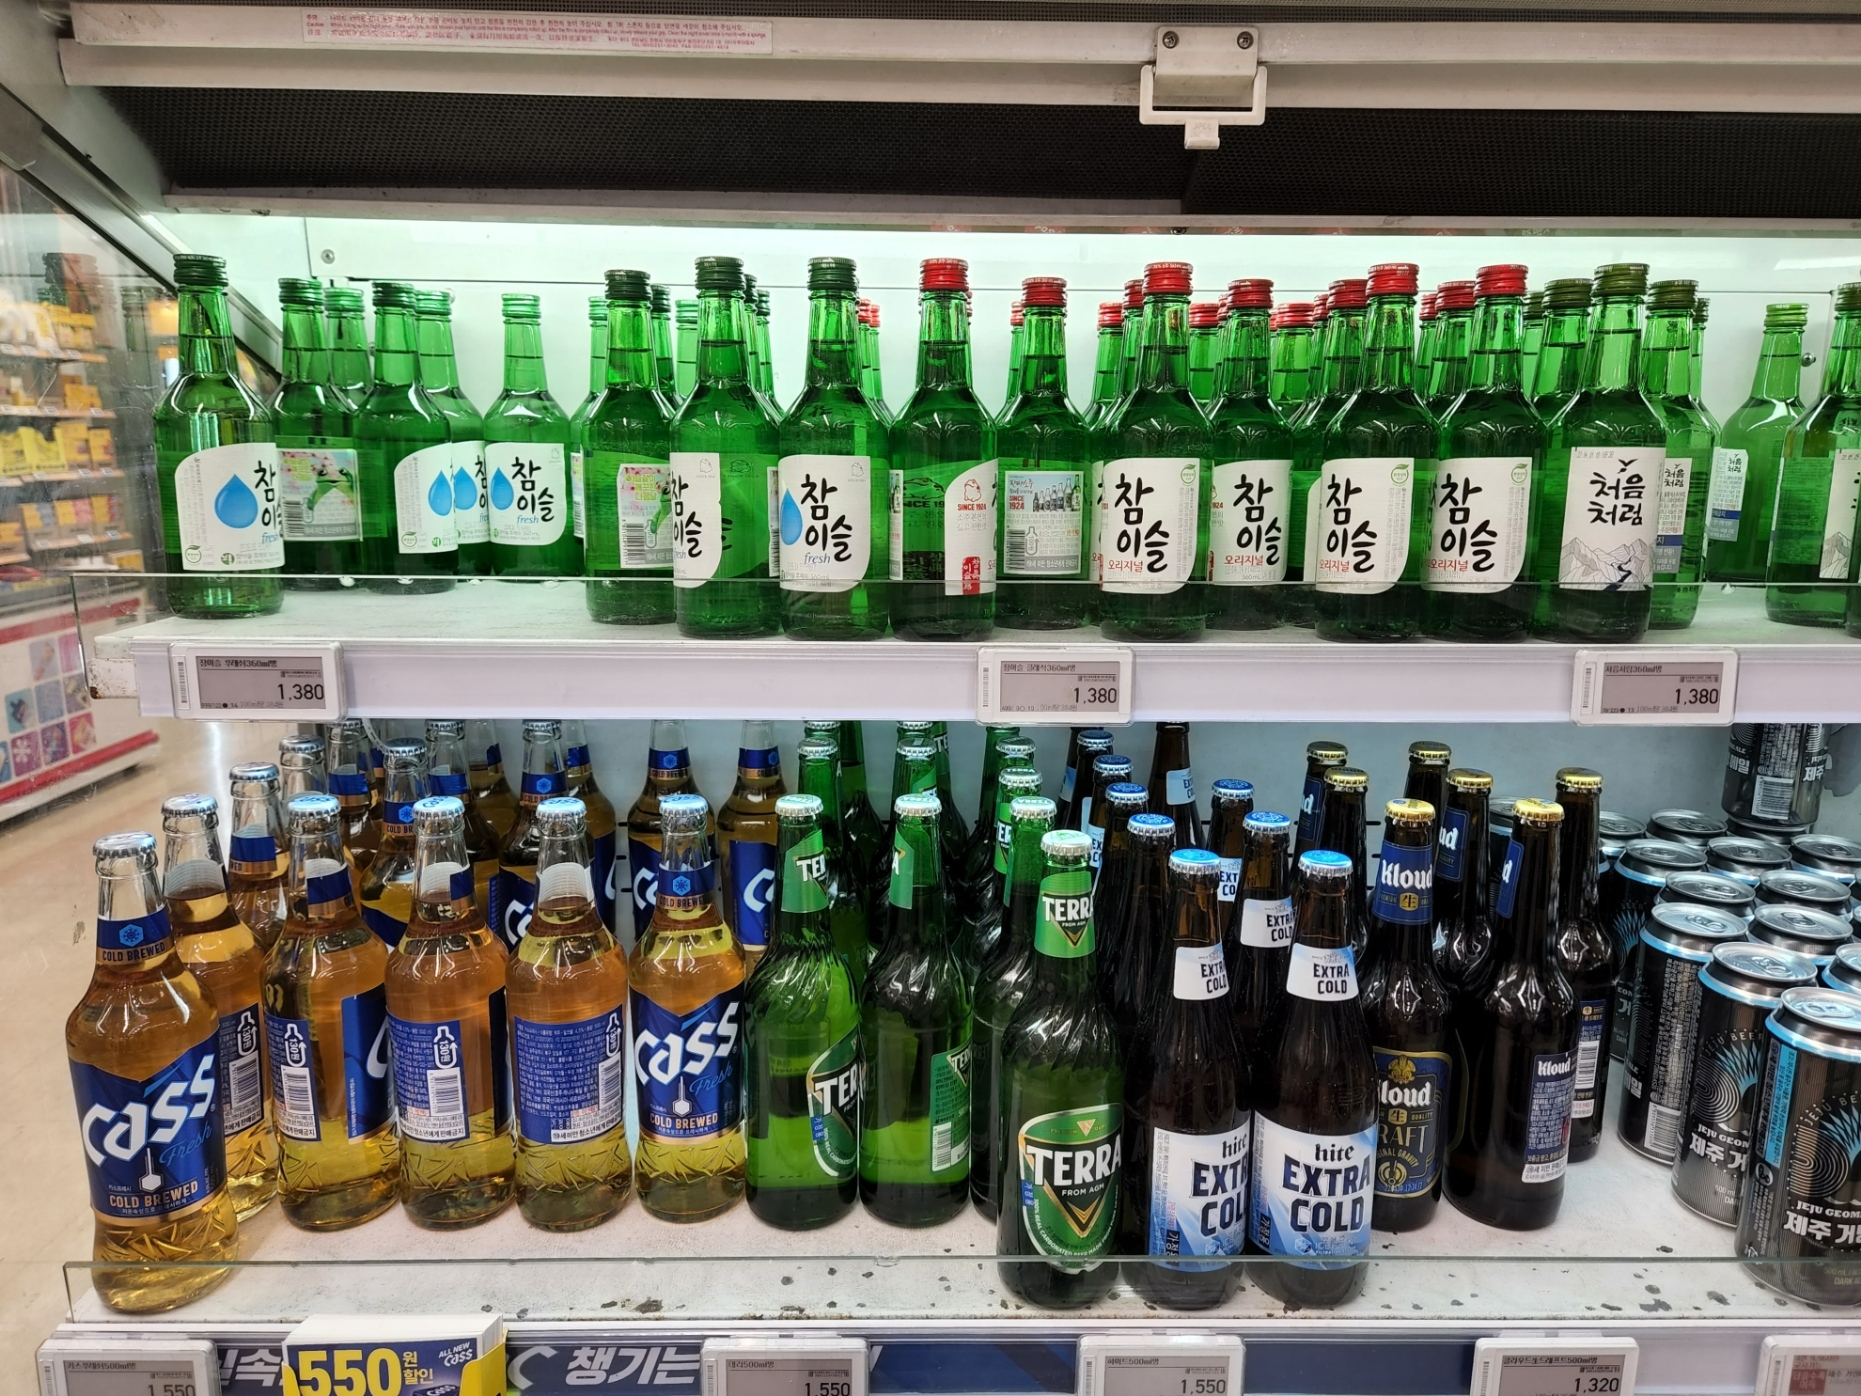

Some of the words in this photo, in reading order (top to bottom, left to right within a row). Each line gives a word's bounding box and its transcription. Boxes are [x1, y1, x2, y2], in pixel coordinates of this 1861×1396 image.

[1728, 457, 1742, 466] 처음
[1664, 478, 1684, 488] 처럼
[1665, 468, 1685, 479] 처음
[511, 456, 555, 523] 참이슬
[1589, 471, 1646, 500] 처음
[958, 503, 975, 511] SINCE
[1009, 502, 1025, 510] 1924
[1587, 500, 1643, 526] 처럼
[517, 515, 539, 527] fresh
[801, 473, 852, 562] 참이슬
[1115, 472, 1169, 574] 참이슬
[1233, 473, 1282, 566] 참이슬
[1326, 473, 1378, 573] 참이슬
[1439, 472, 1498, 573] 참이슬
[804, 552, 831, 565] fresh
[1107, 559, 1144, 573] 오리지널
[1223, 555, 1264, 566] 오리지널
[1319, 559, 1350, 573] 오리지널
[1430, 559, 1469, 572] 오리지널
[277, 683, 324, 701] 1,380
[1073, 687, 1117, 704] 1,380
[1675, 688, 1719, 706] 1,380
[795, 853, 827, 882] TER
[1219, 870, 1239, 883] EXT
[1222, 884, 1236, 896] CO
[660, 896, 675, 909] COLD
[1401, 894, 1417, 909] 生
[102, 949, 123, 962] COLD
[127, 941, 166, 961] BREWED
[1201, 961, 1226, 979] EXTR
[1313, 962, 1350, 979] EXTRA
[1317, 980, 1348, 995] COLD
[437, 1040, 451, 1063] 130원
[1537, 1058, 1571, 1077] Kloud
[689, 1062, 733, 1095] Fresh
[815, 1064, 858, 1117] TER
[1379, 1081, 1432, 1107] loud
[1389, 1109, 1407, 1124] 生
[1411, 1111, 1433, 1121] QUALITY
[1804, 1102, 1832, 1126] JEJU
[1839, 1094, 1861, 1106] BE
[650, 1113, 673, 1129] COLD
[674, 1111, 719, 1130] BREWED
[158, 1120, 213, 1166] Fresh
[1222, 1132, 1248, 1159] hite
[1379, 1124, 1429, 1154] RAFT
[1697, 1123, 1718, 1139] JEJU
[1718, 1132, 1750, 1149] GEOM
[1026, 1133, 1122, 1187] TERRA
[1315, 1143, 1355, 1162] hite
[1398, 1149, 1419, 1168] GRAVITY
[1689, 1131, 1725, 1163] 제주
[1726, 1155, 1749, 1177] 거
[1190, 1152, 1248, 1198] EXTR
[1281, 1153, 1370, 1197] EXTRA
[109, 1192, 141, 1208] COLD
[143, 1179, 199, 1208] BREWED
[1061, 1188, 1087, 1197] FROM
[1089, 1183, 1105, 1194] AGM
[1200, 1185, 1248, 1237] COL
[1289, 1195, 1365, 1234] COLD
[1796, 1199, 1824, 1214] JEJU
[1825, 1207, 1861, 1219] GEOM
[1034, 1211, 1042, 1229] REAL
[1784, 1210, 1833, 1242] 제주
[403, 1351, 418, 1368] 원
[438, 1348, 452, 1359] ALL
[453, 1341, 471, 1355] NEW
[298, 1348, 401, 1396] 550
[565, 1346, 700, 1386] 챙기는
[403, 1368, 434, 1386] 할인
[1180, 1378, 1227, 1395] 1,550
[1573, 1377, 1620, 1394] 1,320
[147, 1384, 196, 1396] 1550
